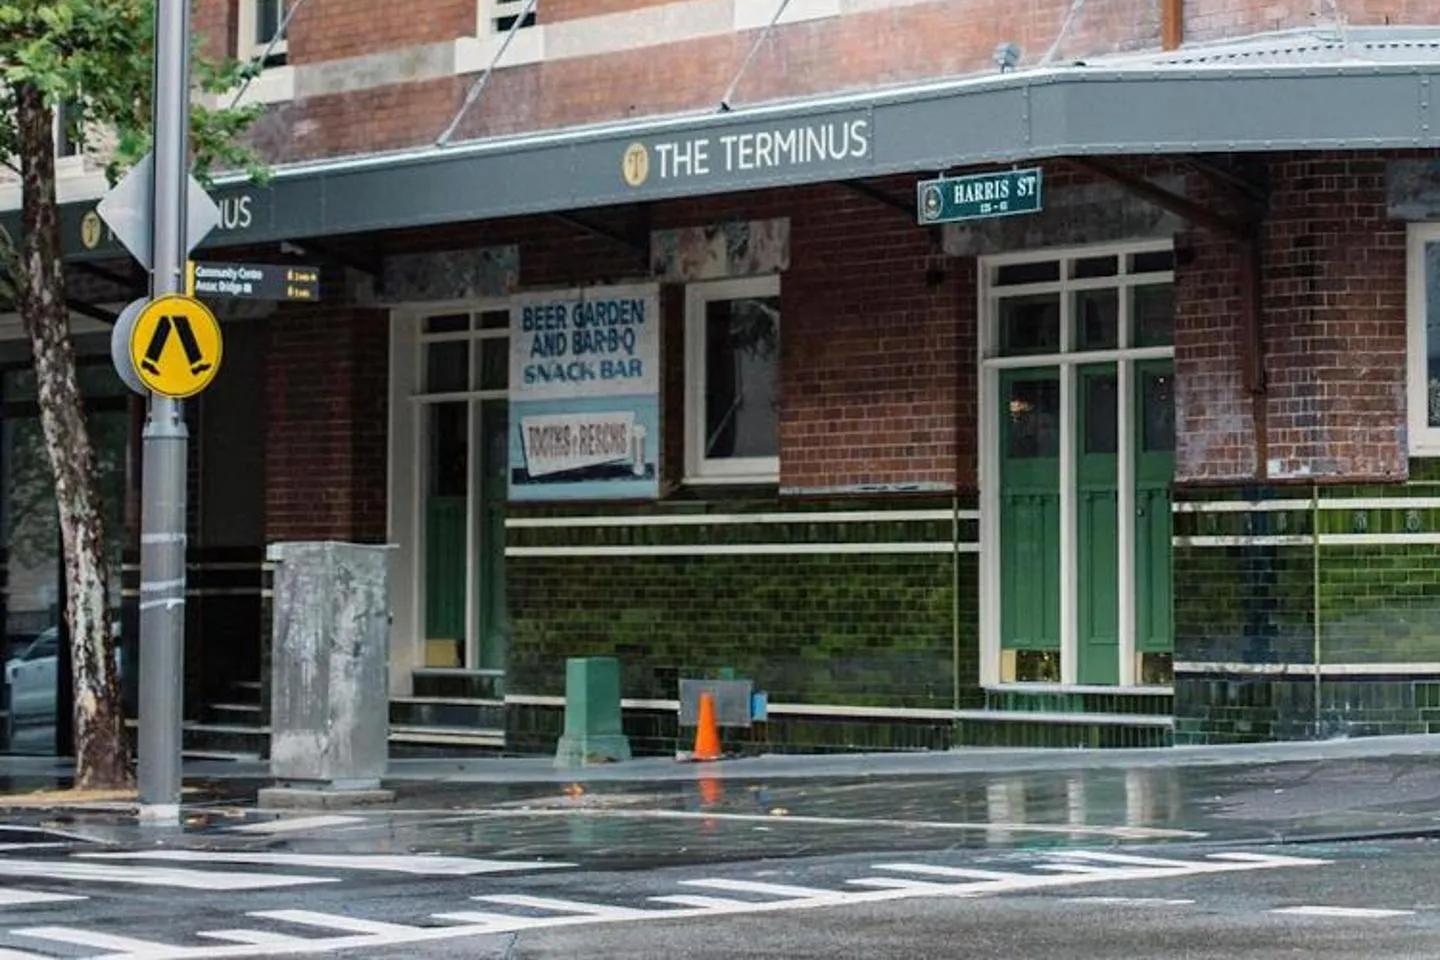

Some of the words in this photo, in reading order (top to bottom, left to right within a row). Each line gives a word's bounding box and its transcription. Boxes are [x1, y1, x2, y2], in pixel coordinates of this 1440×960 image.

[655, 139, 710, 179] THE
[720, 120, 868, 172] TERMINUS
[953, 179, 1009, 205] HARRIS
[1016, 176, 1036, 197] ST
[523, 304, 567, 332] BEER
[572, 299, 645, 329] GARDEN
[530, 331, 567, 358] AND
[524, 362, 596, 384] SNACK
[600, 358, 643, 379] BAR
